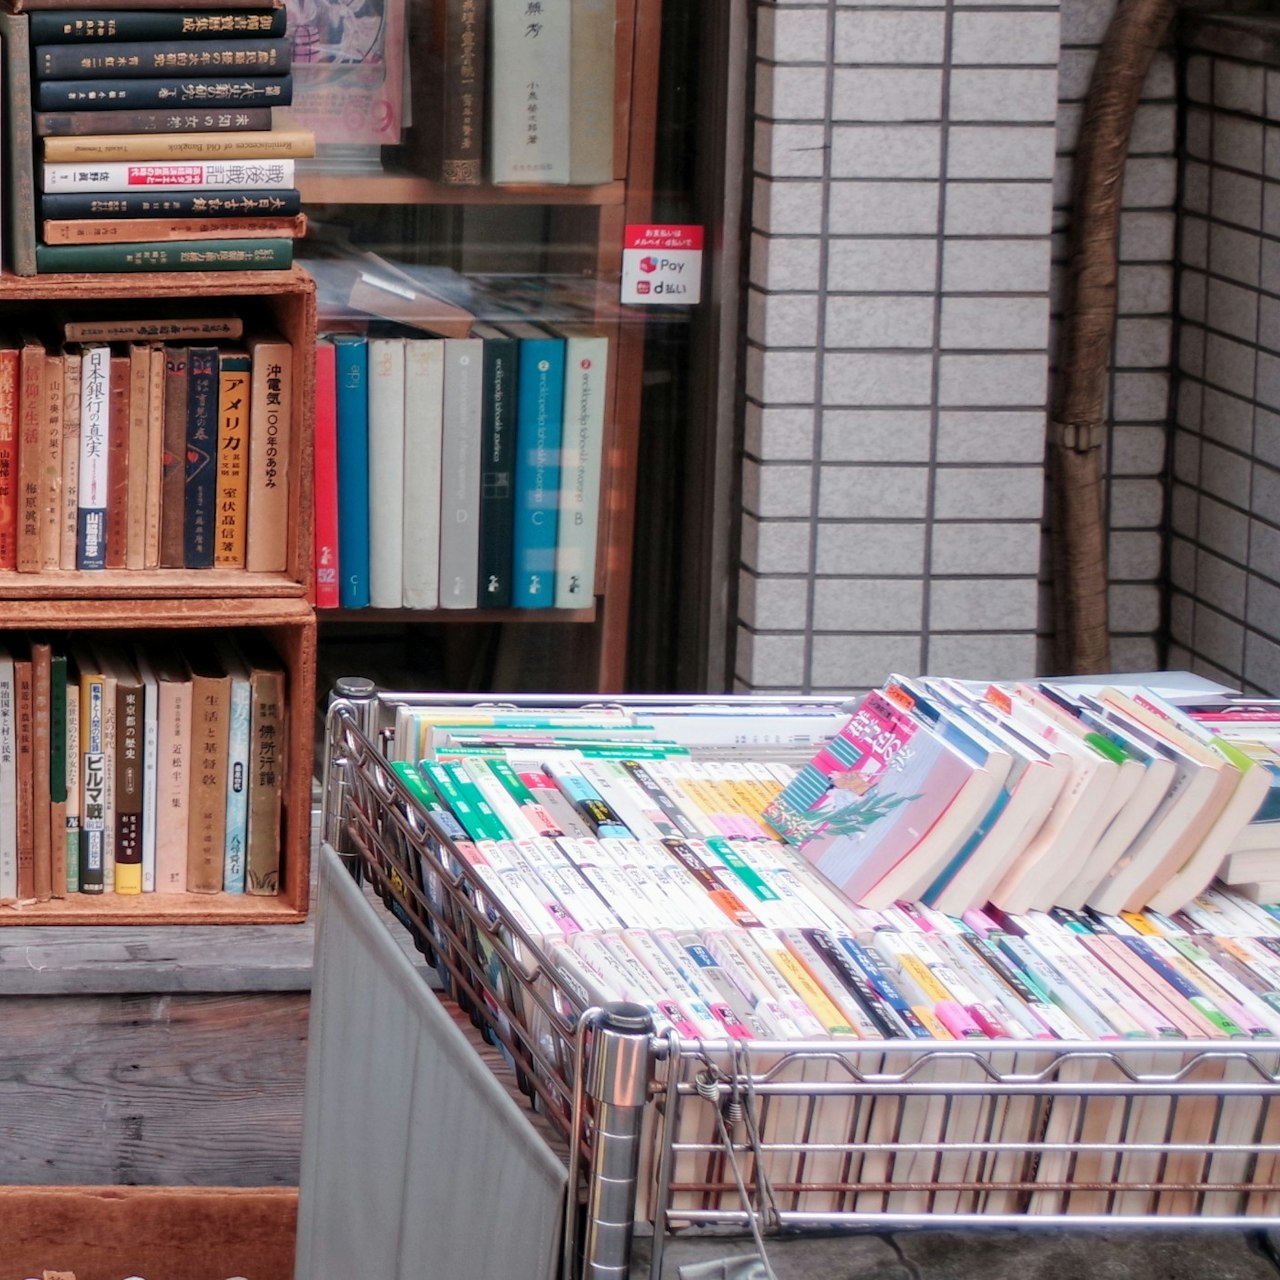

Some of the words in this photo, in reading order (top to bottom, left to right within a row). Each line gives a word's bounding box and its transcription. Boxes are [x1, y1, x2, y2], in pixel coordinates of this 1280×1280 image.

[661, 259, 685, 273] Pay
[86, 352, 104, 458] 日本銀行の真実
[224, 378, 242, 451] アメリカ
